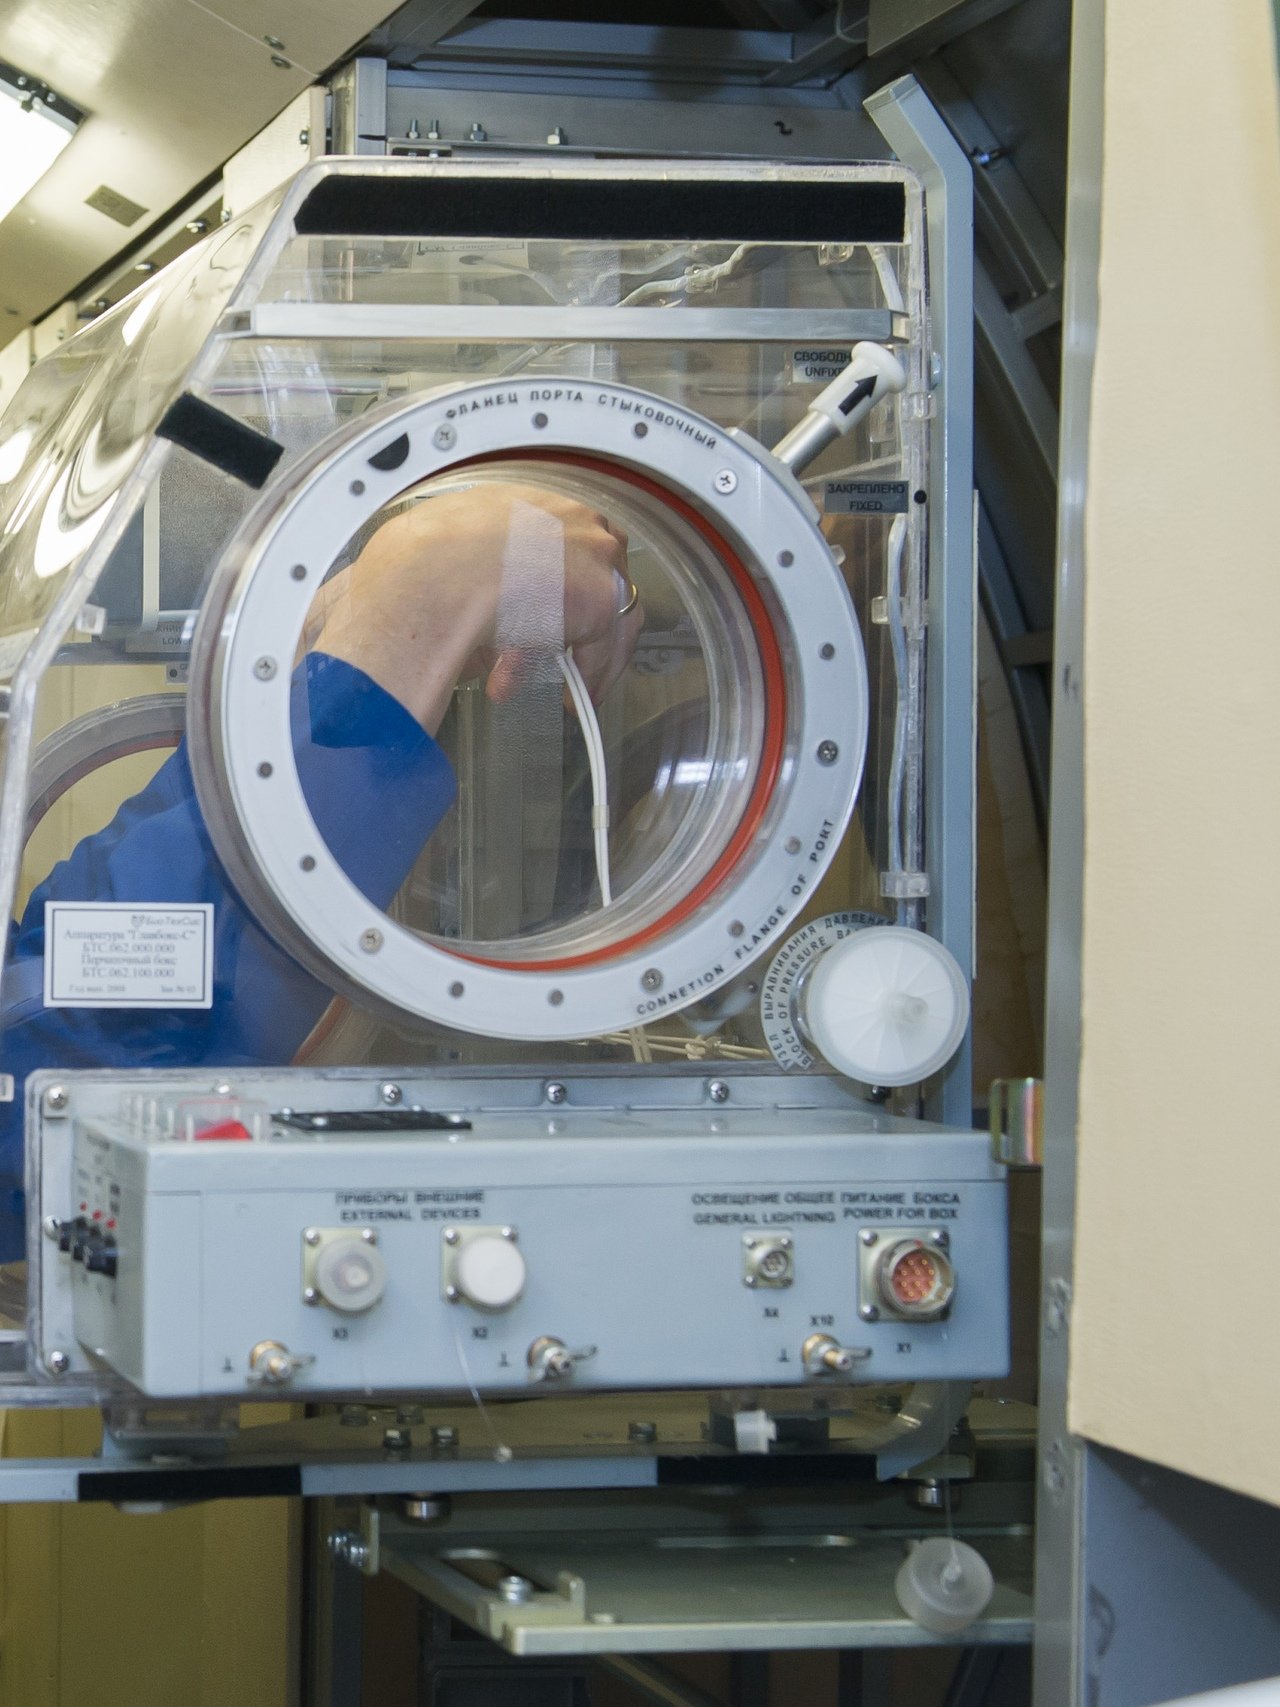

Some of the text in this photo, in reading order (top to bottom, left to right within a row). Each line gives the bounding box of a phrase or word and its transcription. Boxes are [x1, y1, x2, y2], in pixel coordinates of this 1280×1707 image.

[794, 351, 851, 362] СВОБОДН
[805, 366, 843, 377] UNFIX
[445, 389, 718, 450] ФЛАНЕЦ ПОРТА СТЫКОВОЧНЫЙ
[827, 483, 905, 494] ЗАКРЕПЛЕНО
[849, 501, 883, 511] FIXED
[636, 818, 835, 1015] CONNETION FLANGE OF PORT
[780, 936, 827, 994] PRESSURE
[764, 925, 817, 1020] ВЫРАВНИВАНИЯ
[778, 1002, 788, 1019] OF
[769, 1034, 792, 1067] УЗЕЛ
[692, 1192, 835, 1206] ОСВЕЩЕНИЕ ОБЩЕЕ
[841, 1192, 960, 1205] ПИТАНИЕ БОКСА
[341, 1207, 481, 1221] EXTERNAL DEVICES
[694, 1211, 835, 1225] GENERAL LIGHTNING
[842, 1207, 958, 1219] POWER FOR BOX
